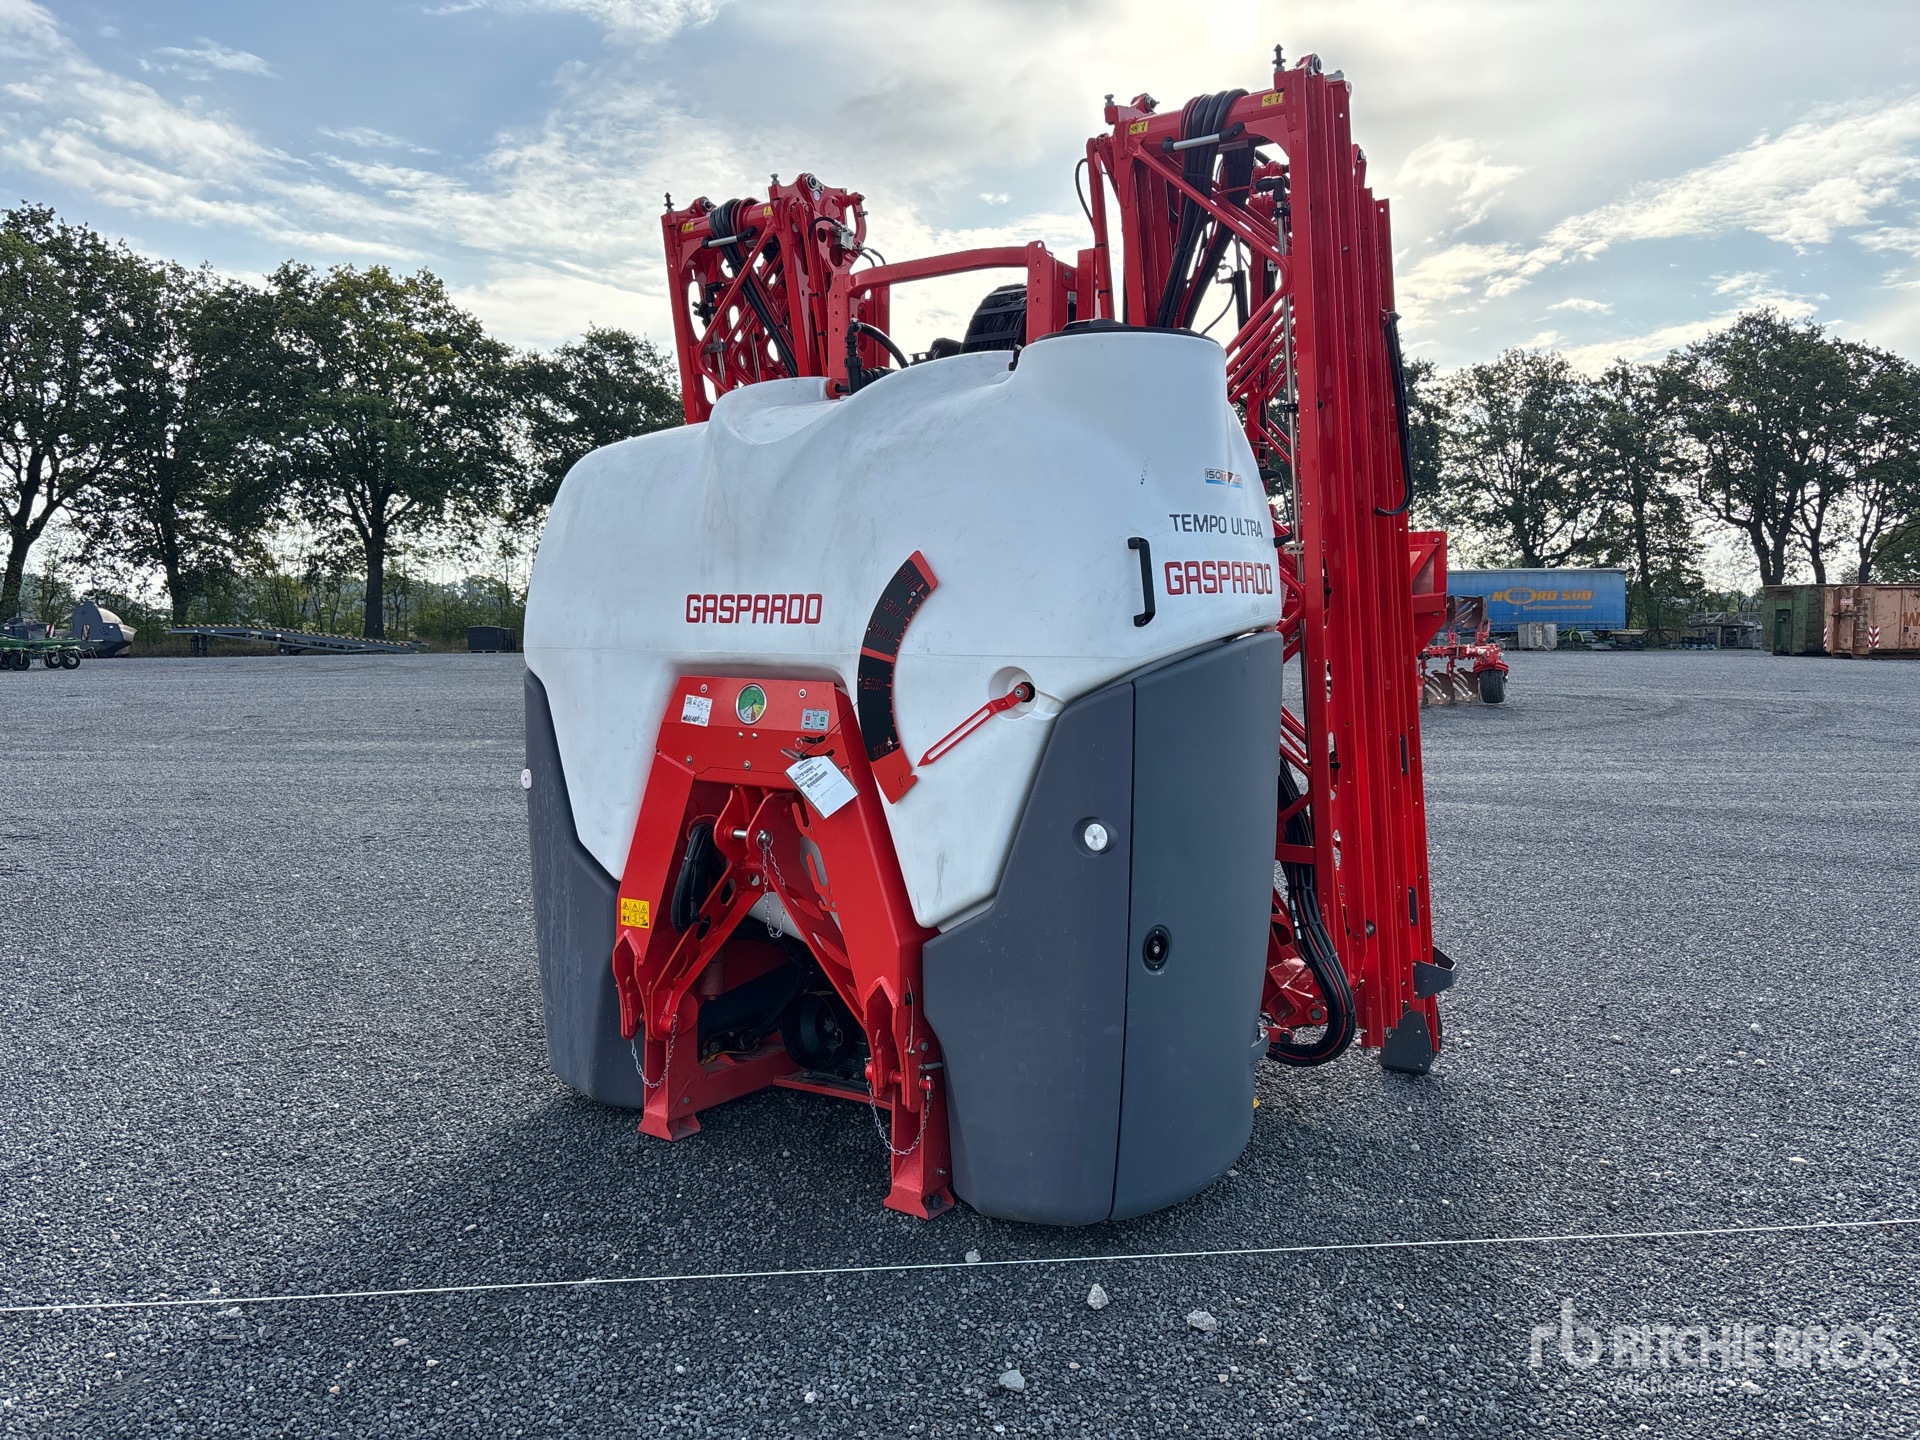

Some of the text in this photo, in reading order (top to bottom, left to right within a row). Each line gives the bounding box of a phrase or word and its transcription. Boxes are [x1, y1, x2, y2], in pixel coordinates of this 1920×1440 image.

[1169, 513, 1263, 538] TEMPO ULTRA
[1164, 560, 1273, 595] GASPARDO
[1492, 587, 1558, 605] NORD
[686, 594, 823, 624] GASPARDO
[863, 677, 883, 691] 500
